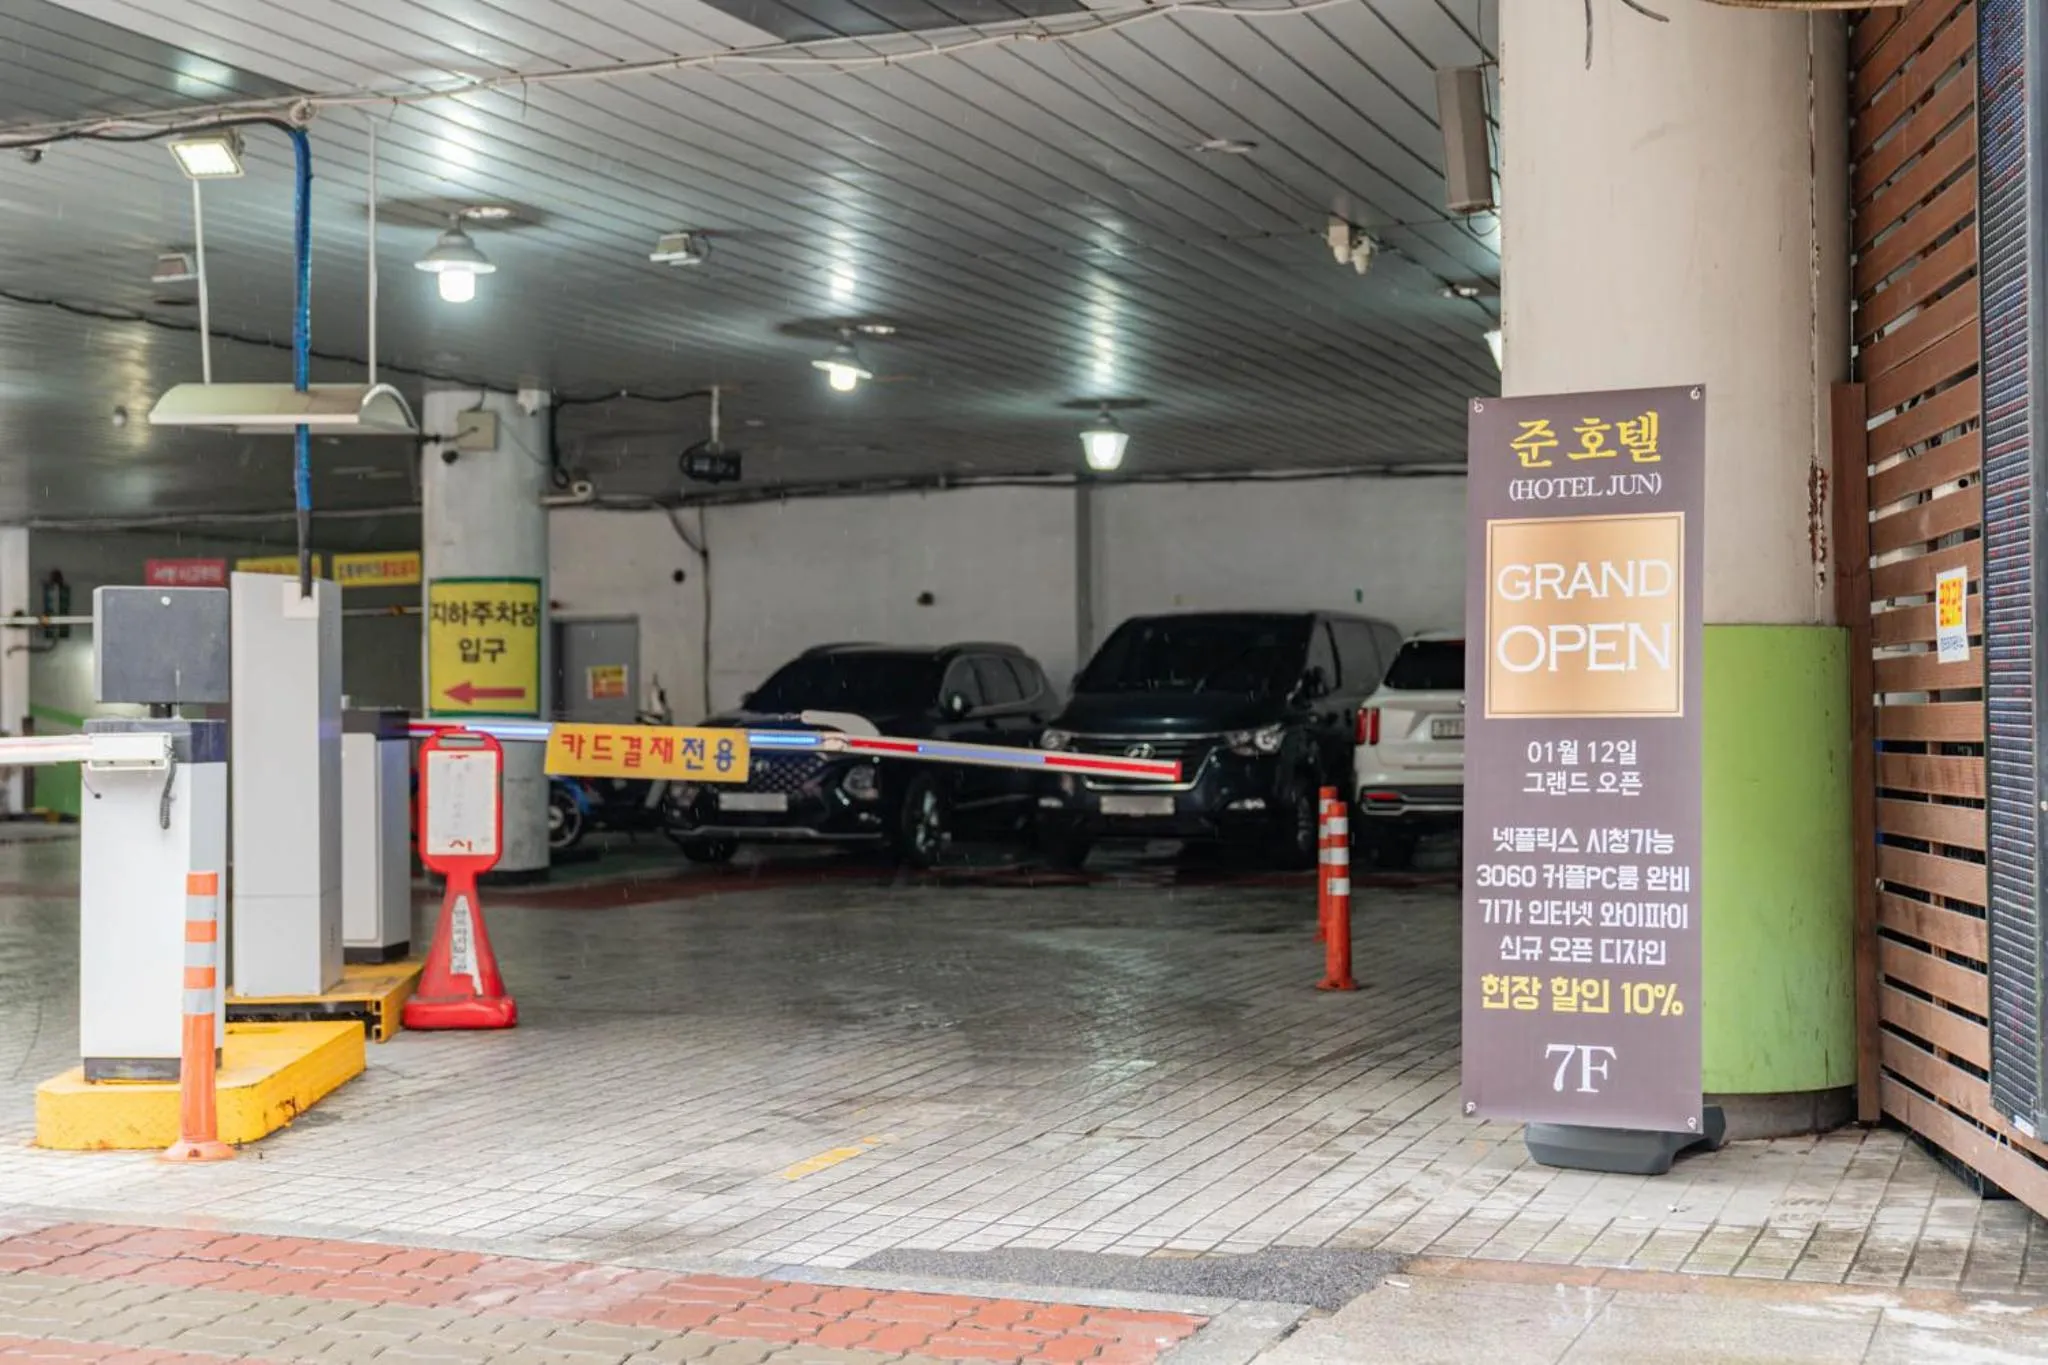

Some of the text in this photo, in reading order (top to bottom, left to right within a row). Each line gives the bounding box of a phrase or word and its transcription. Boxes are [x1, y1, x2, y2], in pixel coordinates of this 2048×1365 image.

[1509, 410, 1662, 468] 준 호텔
[1509, 472, 1662, 501] (HOTEL JUN)
[1497, 558, 1673, 601] GRAND
[431, 600, 541, 627] 지하주차장
[458, 638, 507, 663] 입구
[1497, 621, 1672, 673] OPEN
[1528, 740, 1636, 765] 01월 12일
[1523, 770, 1642, 796] 그랜드 오픈
[1493, 827, 1674, 854] 넷플릭스 시청가능
[1477, 864, 1690, 892] 3060 커플PC룸 완비
[1479, 899, 1688, 929] 기가 인터넷 와이파이
[1500, 936, 1666, 965] 신규 오픈 디자인
[1481, 974, 1684, 1016] 현장 할인 10%
[1545, 1044, 1616, 1093] 7F
